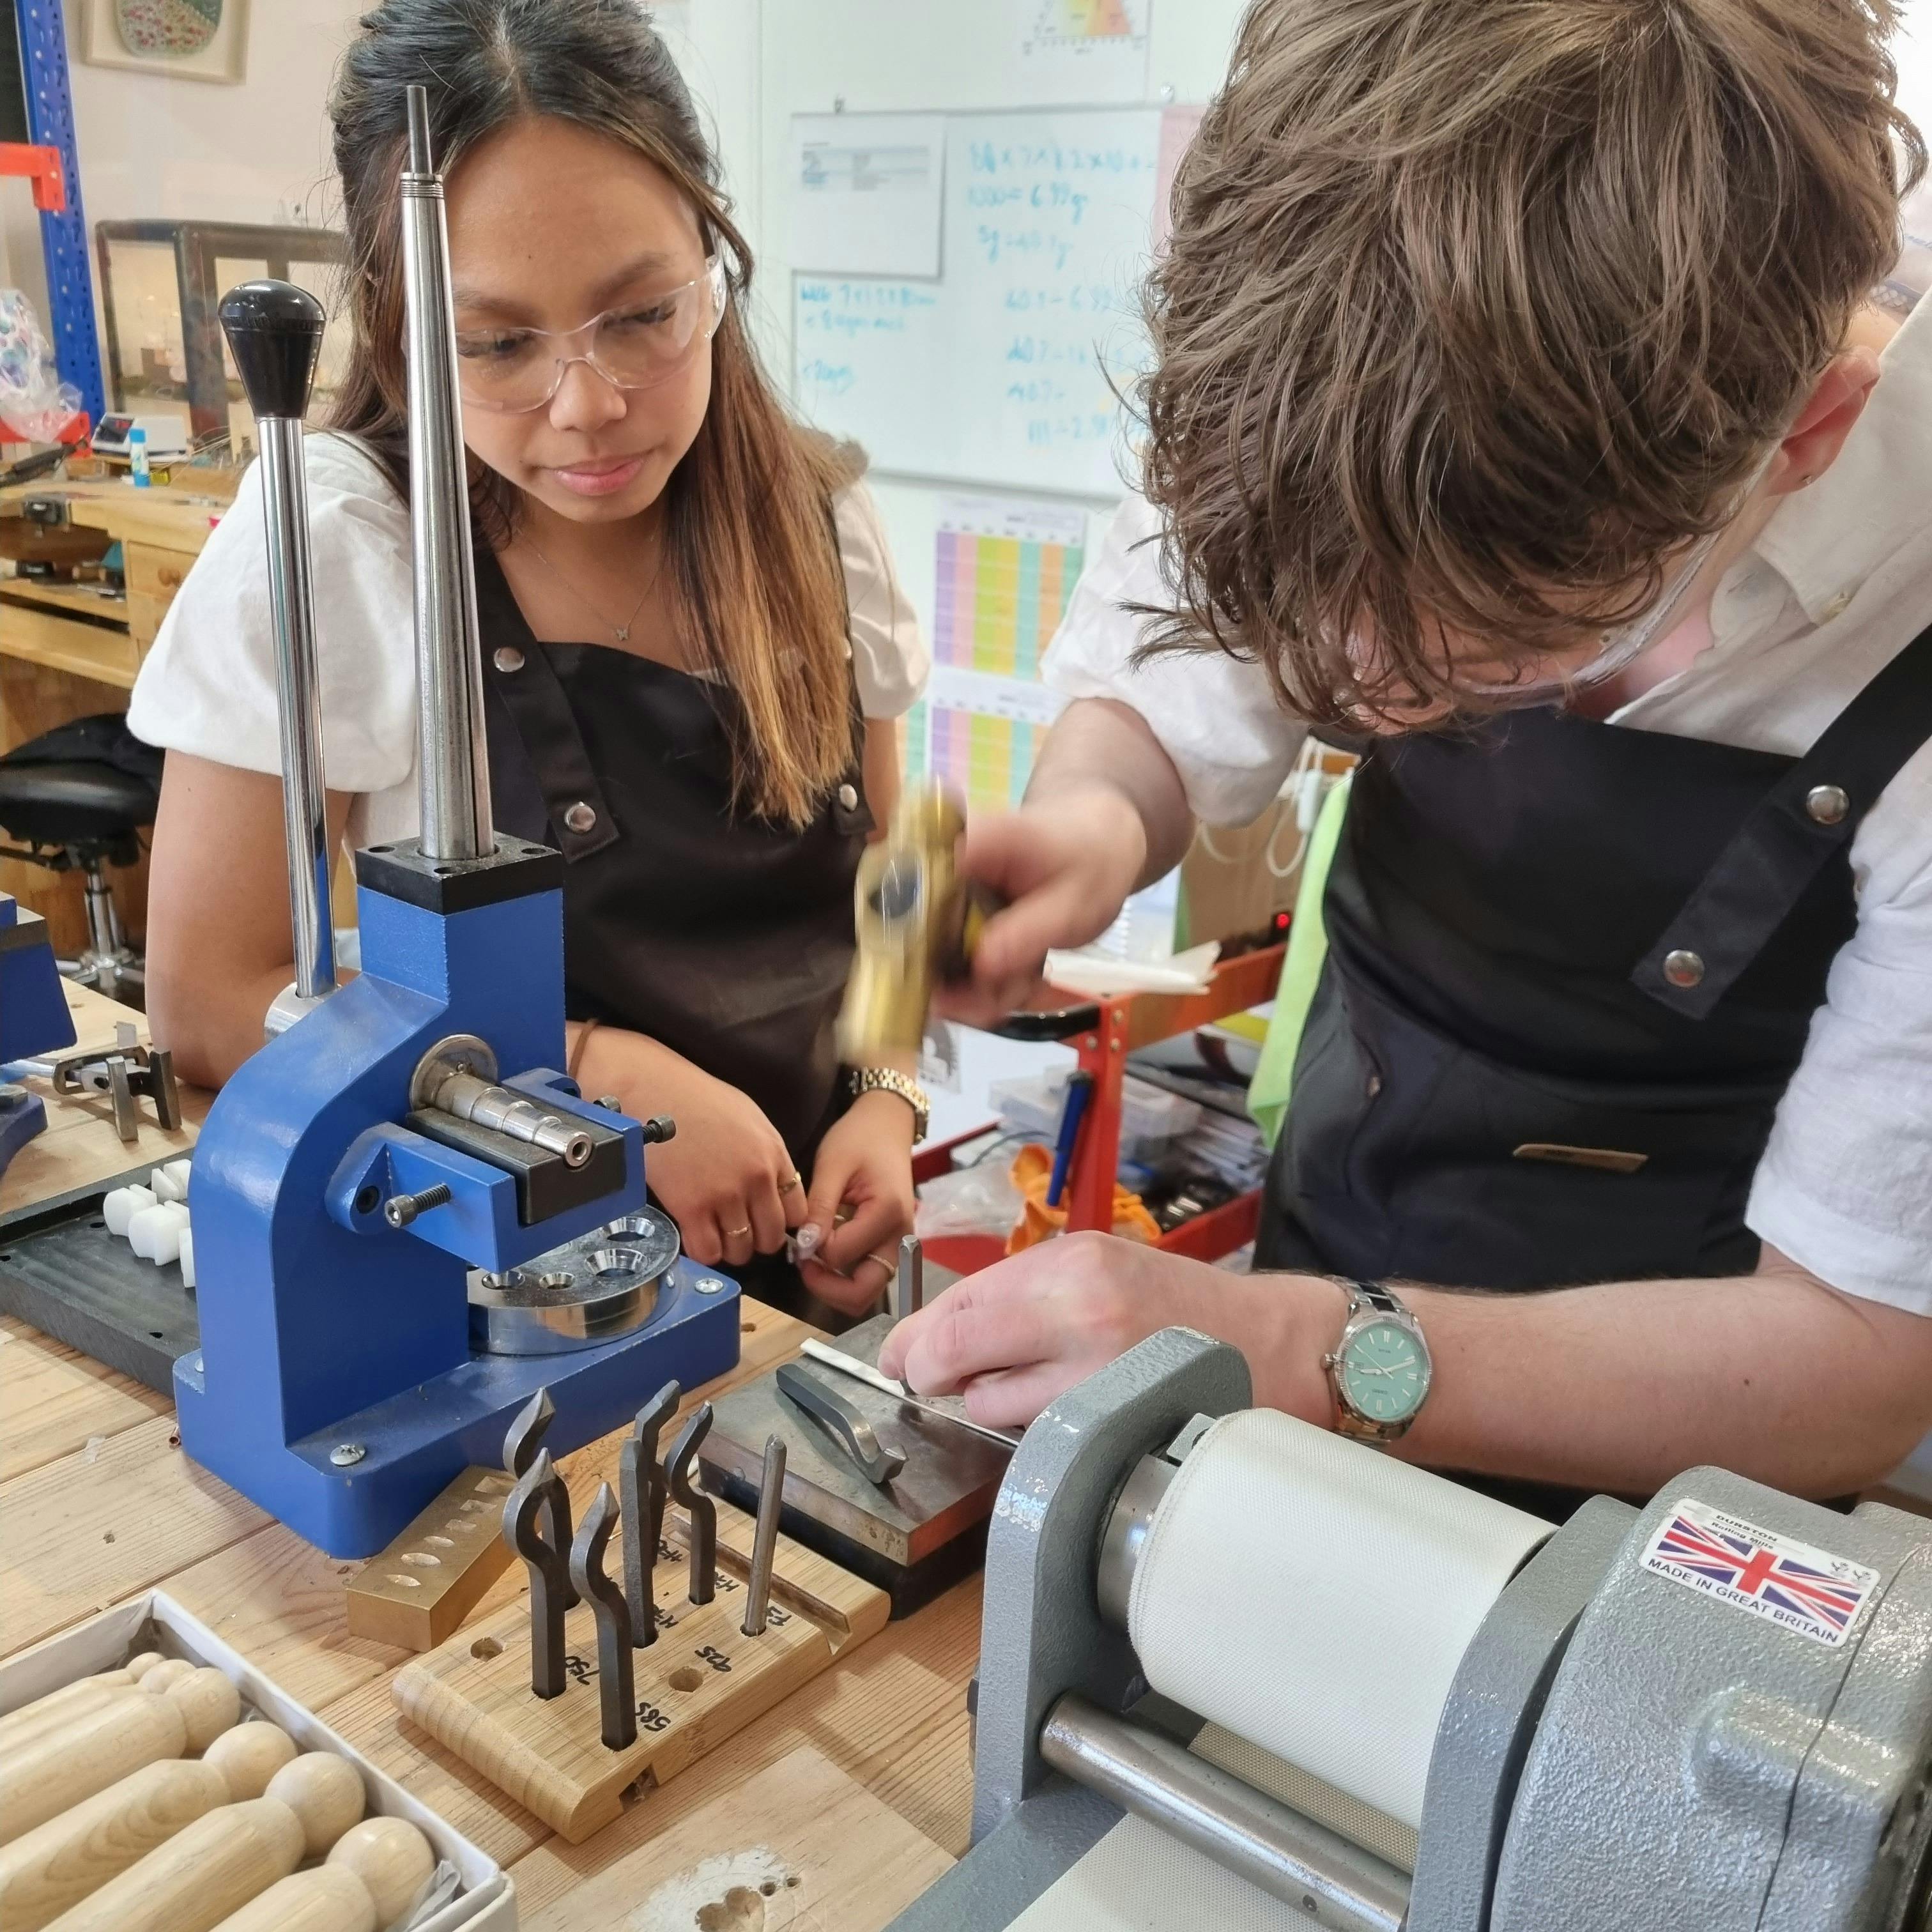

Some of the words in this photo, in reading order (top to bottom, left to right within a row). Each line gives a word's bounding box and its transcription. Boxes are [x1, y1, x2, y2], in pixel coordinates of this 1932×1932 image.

[1648, 1558, 1692, 1582] MADE
[1696, 1577, 1712, 1590] IN
[1716, 1586, 1770, 1613] GREAT
[1774, 1609, 1839, 1643] BRITAIN
[565, 1656, 600, 1685] 750
[694, 1646, 732, 1672] 925
[635, 1702, 671, 1731] 585
